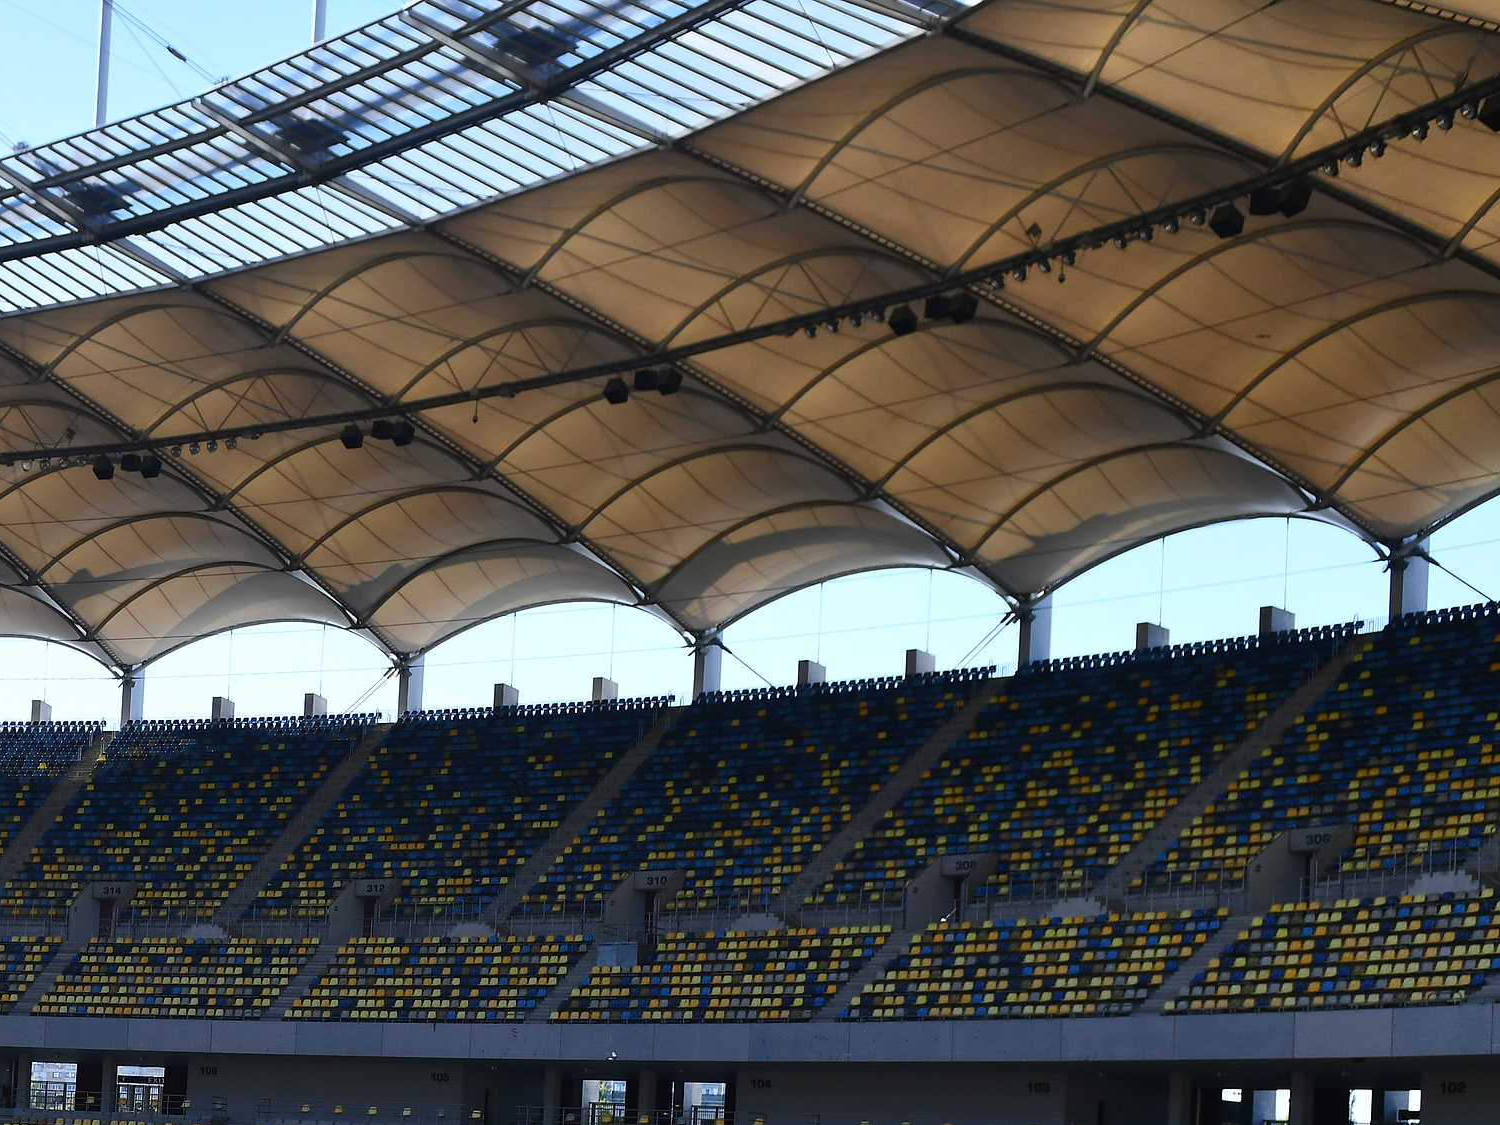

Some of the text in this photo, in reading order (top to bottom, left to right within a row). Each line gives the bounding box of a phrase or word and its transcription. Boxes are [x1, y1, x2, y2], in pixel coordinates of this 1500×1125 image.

[646, 876, 667, 885] 310
[103, 886, 121, 895] 314
[366, 884, 385, 893] 312
[199, 1066, 218, 1075] 106
[430, 1073, 450, 1082] 105
[750, 1079, 772, 1089] 104
[1027, 1082, 1050, 1093] 103
[1439, 1081, 1467, 1094] 102
